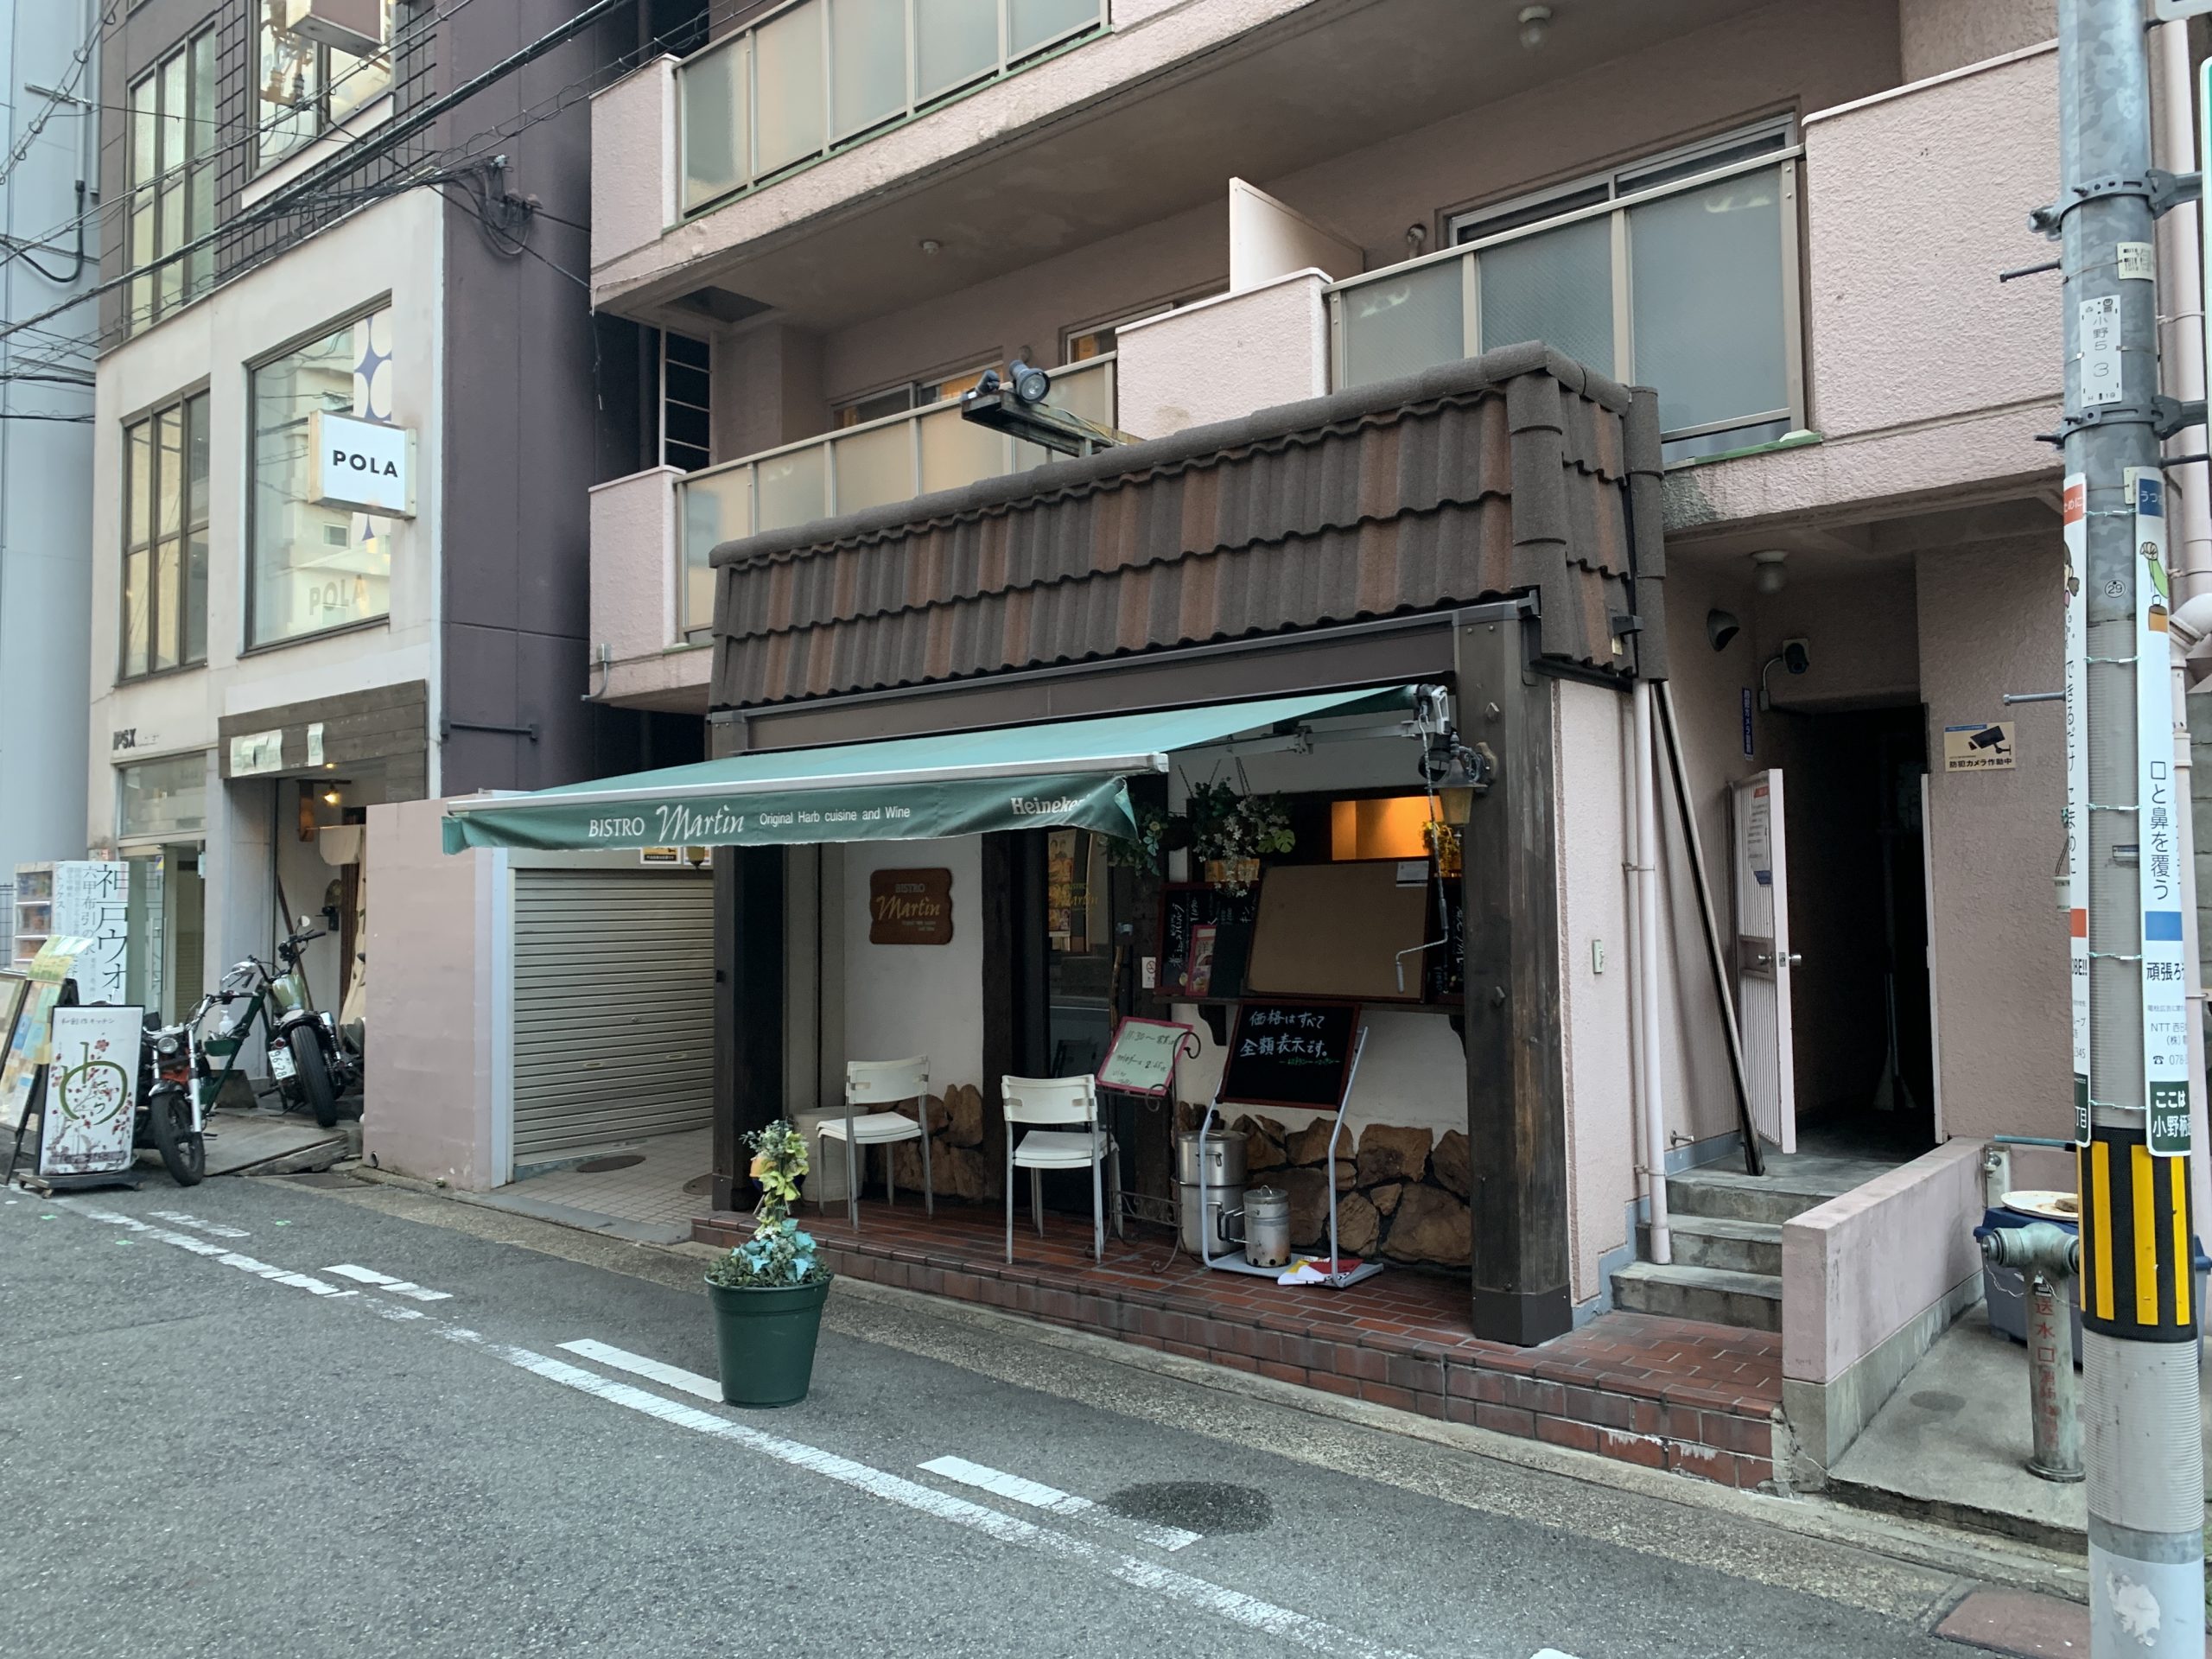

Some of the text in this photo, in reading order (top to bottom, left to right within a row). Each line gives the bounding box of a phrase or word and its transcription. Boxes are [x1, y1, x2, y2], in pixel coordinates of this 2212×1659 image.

[333, 449, 398, 478] POLA
[308, 574, 366, 616] POLA
[2107, 583, 2123, 594] 29
[1948, 757, 2012, 769] 防犯カメラ作動中
[1010, 794, 1090, 815] Heineke
[588, 817, 645, 837] BISTRO
[760, 811, 793, 826] Original
[798, 810, 820, 823] Harb
[824, 809, 857, 822] cuisine
[861, 807, 880, 820] and
[885, 805, 911, 819] Wine
[2149, 760, 2170, 900] 口と鼻を覆う
[895, 883, 926, 893] BISTRO
[2146, 962, 2185, 982] 頑張ろ
[1249, 1009, 1325, 1029] 価格はすべて
[2151, 1022, 2171, 1033] NTT
[2155, 1090, 2186, 1109] ここは
[2035, 1298, 2056, 1363] 送水口
